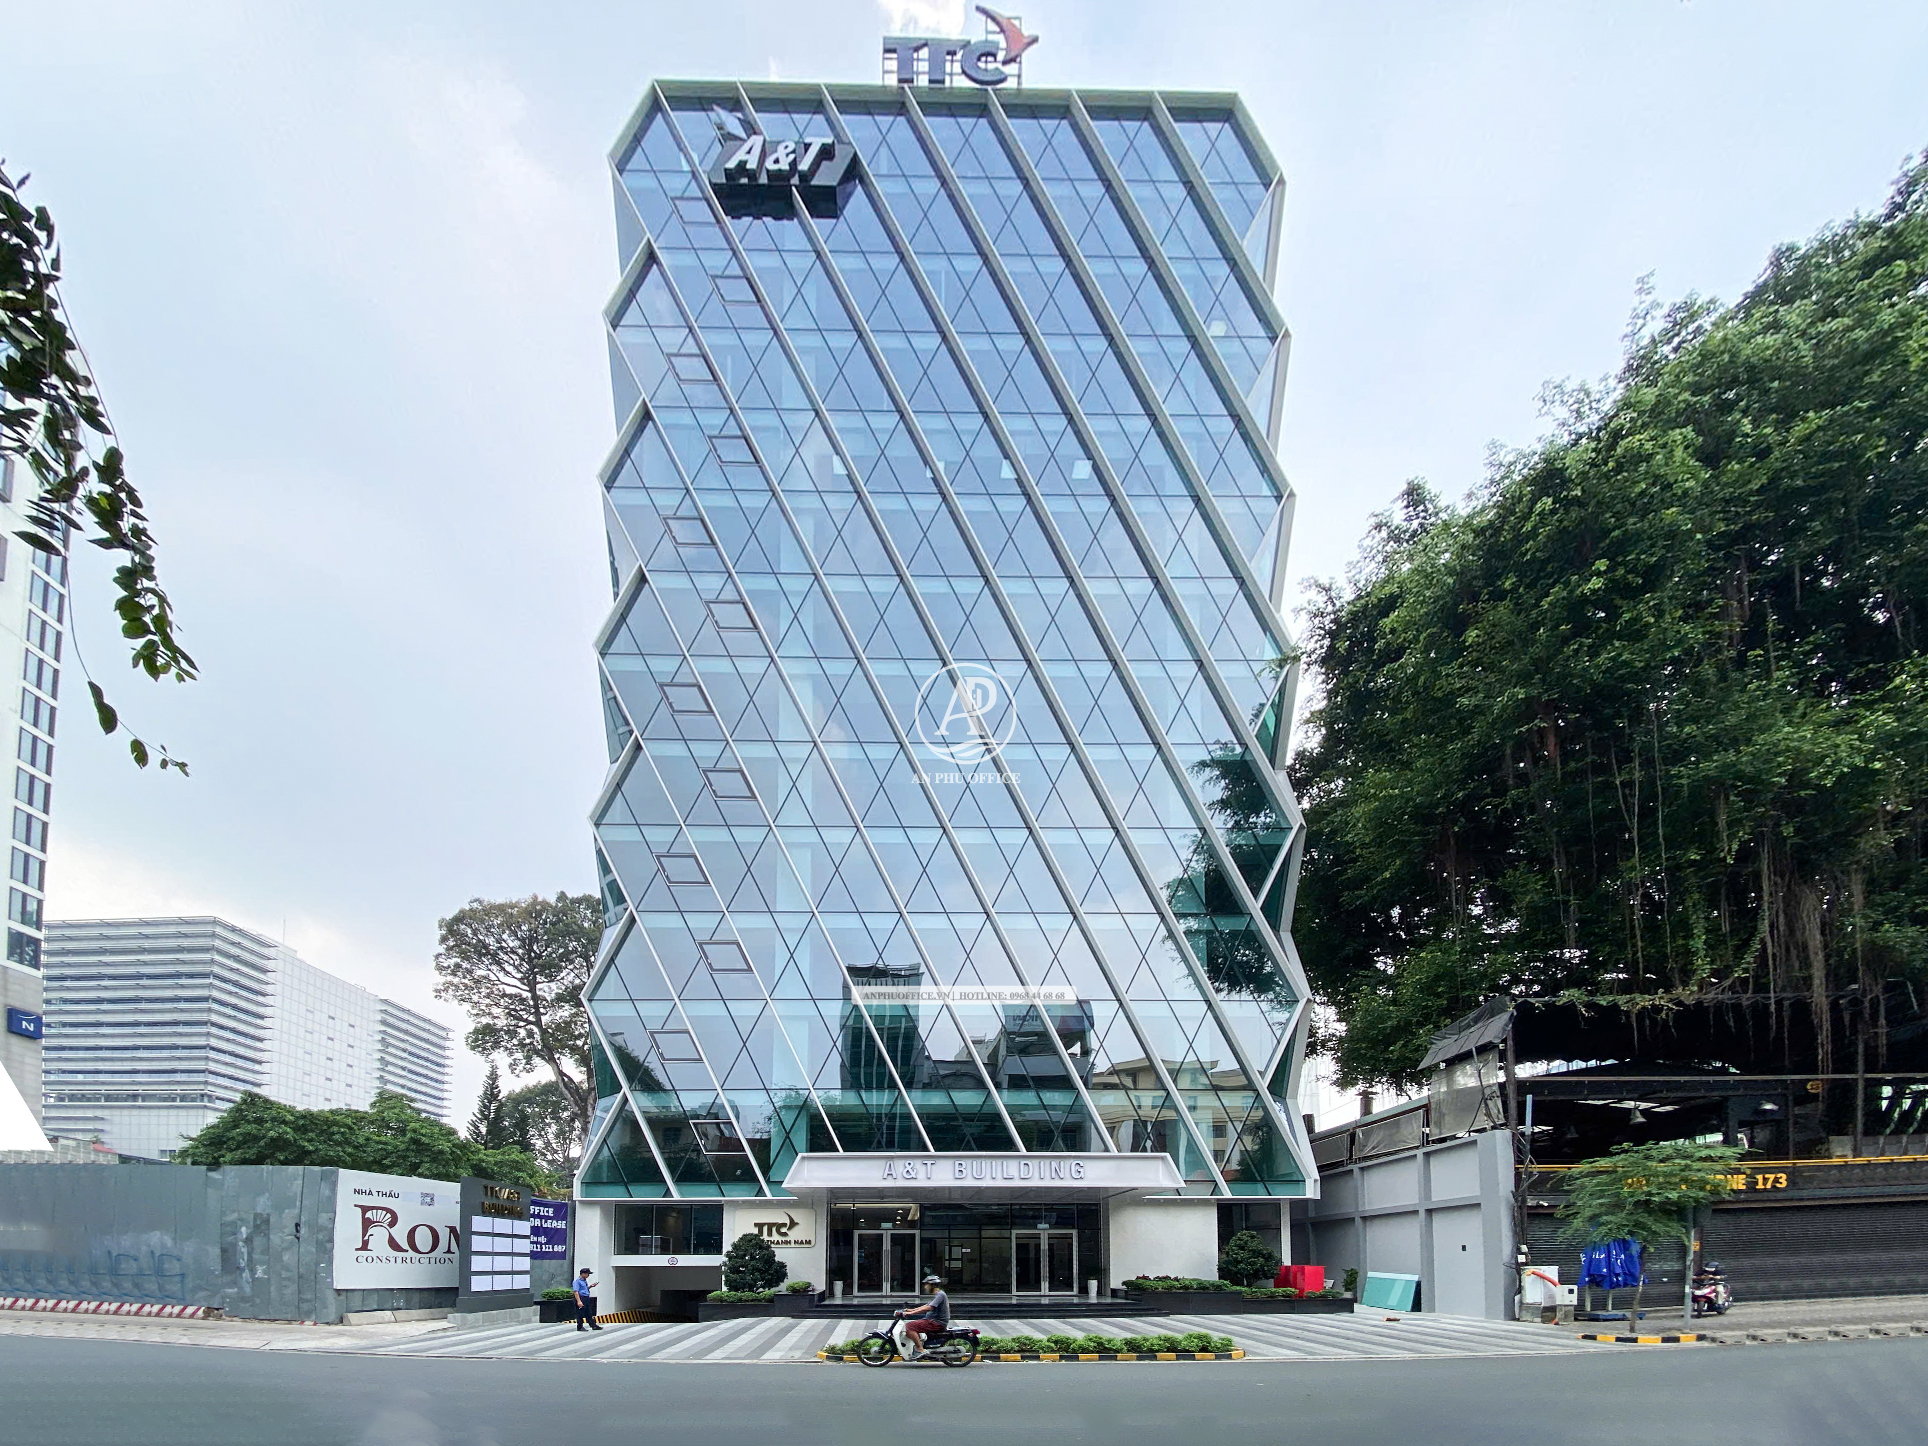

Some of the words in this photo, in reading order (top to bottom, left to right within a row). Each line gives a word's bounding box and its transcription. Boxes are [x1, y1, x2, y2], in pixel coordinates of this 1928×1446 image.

[883, 36, 1008, 85] TTC
[724, 134, 835, 178] A&T
[882, 1160, 936, 1180] A&T
[953, 1160, 1086, 1180] BUILDING
[1755, 1173, 1788, 1189] 173
[353, 1187, 374, 1197] NHÀ
[530, 1205, 554, 1217] FFICE
[530, 1217, 541, 1227] OR
[542, 1219, 567, 1229] LEASE
[753, 1222, 789, 1237] TTC
[355, 1255, 454, 1265] CONSTRUCTION
